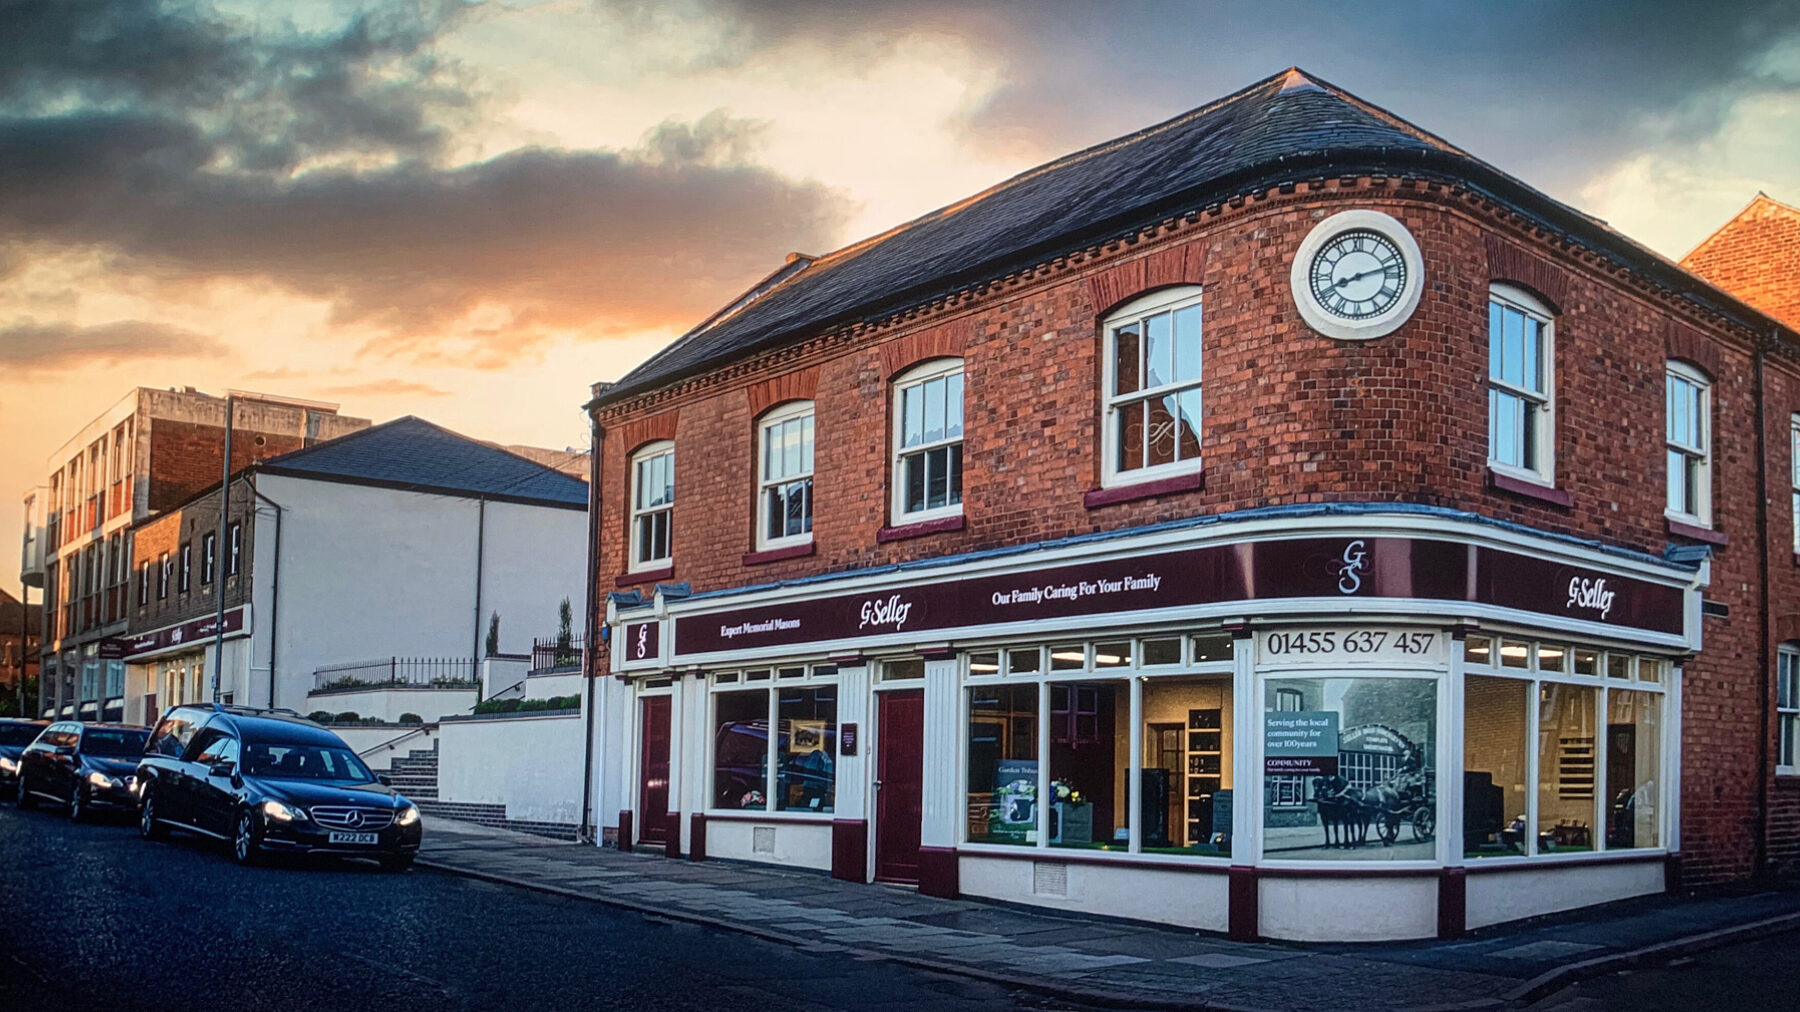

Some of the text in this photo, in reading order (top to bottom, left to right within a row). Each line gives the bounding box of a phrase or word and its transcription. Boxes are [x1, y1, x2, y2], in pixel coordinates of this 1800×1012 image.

[992, 573, 1161, 606] Our Family Caring For Your Family
[720, 618, 800, 639] Expert Memorial Masons
[1267, 630, 1435, 655] 01455 637 457
[1267, 718, 1329, 728] Serving the local
[1267, 728, 1322, 739] community for
[1266, 759, 1312, 767] COMMUNITY
